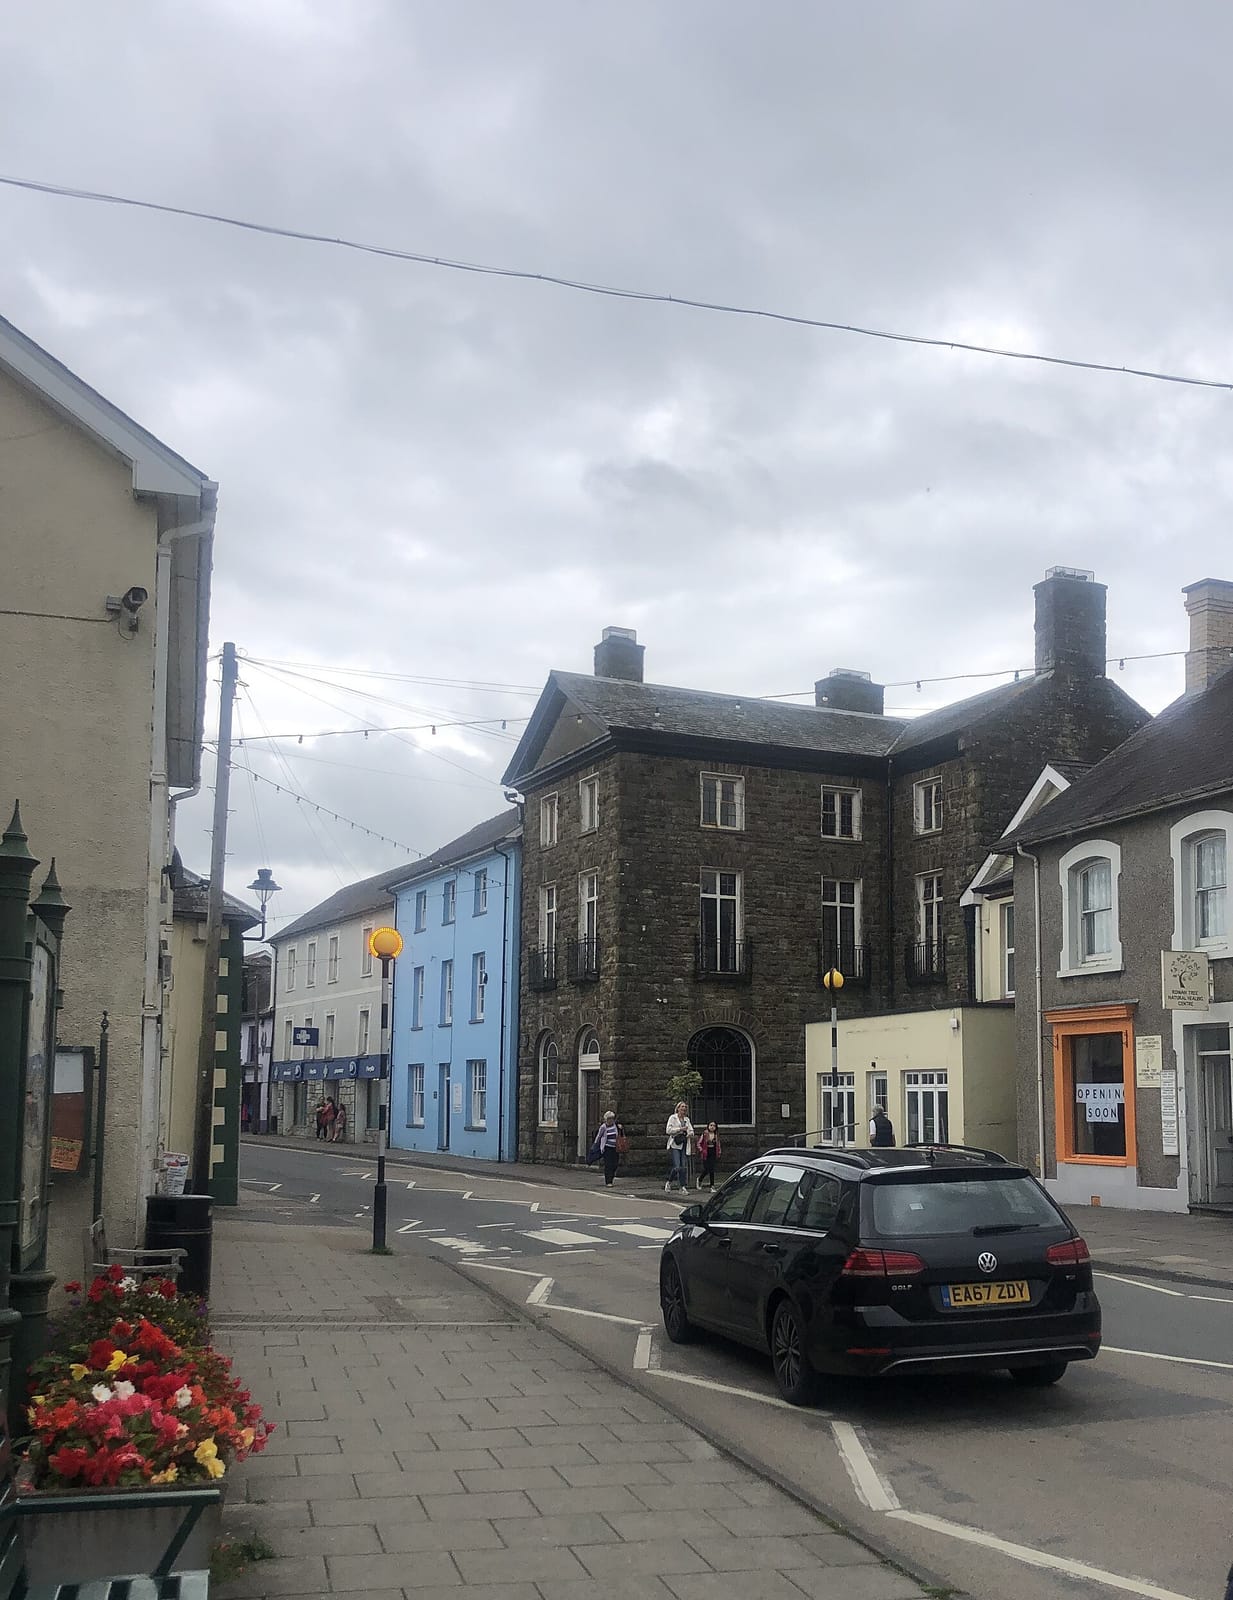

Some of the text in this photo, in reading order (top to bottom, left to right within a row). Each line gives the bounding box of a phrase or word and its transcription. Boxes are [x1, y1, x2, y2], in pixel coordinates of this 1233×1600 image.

[1078, 1089, 1125, 1099] OPENIN
[1088, 1107, 1117, 1118] SOON
[951, 1281, 1025, 1302] EA67 ZDY
